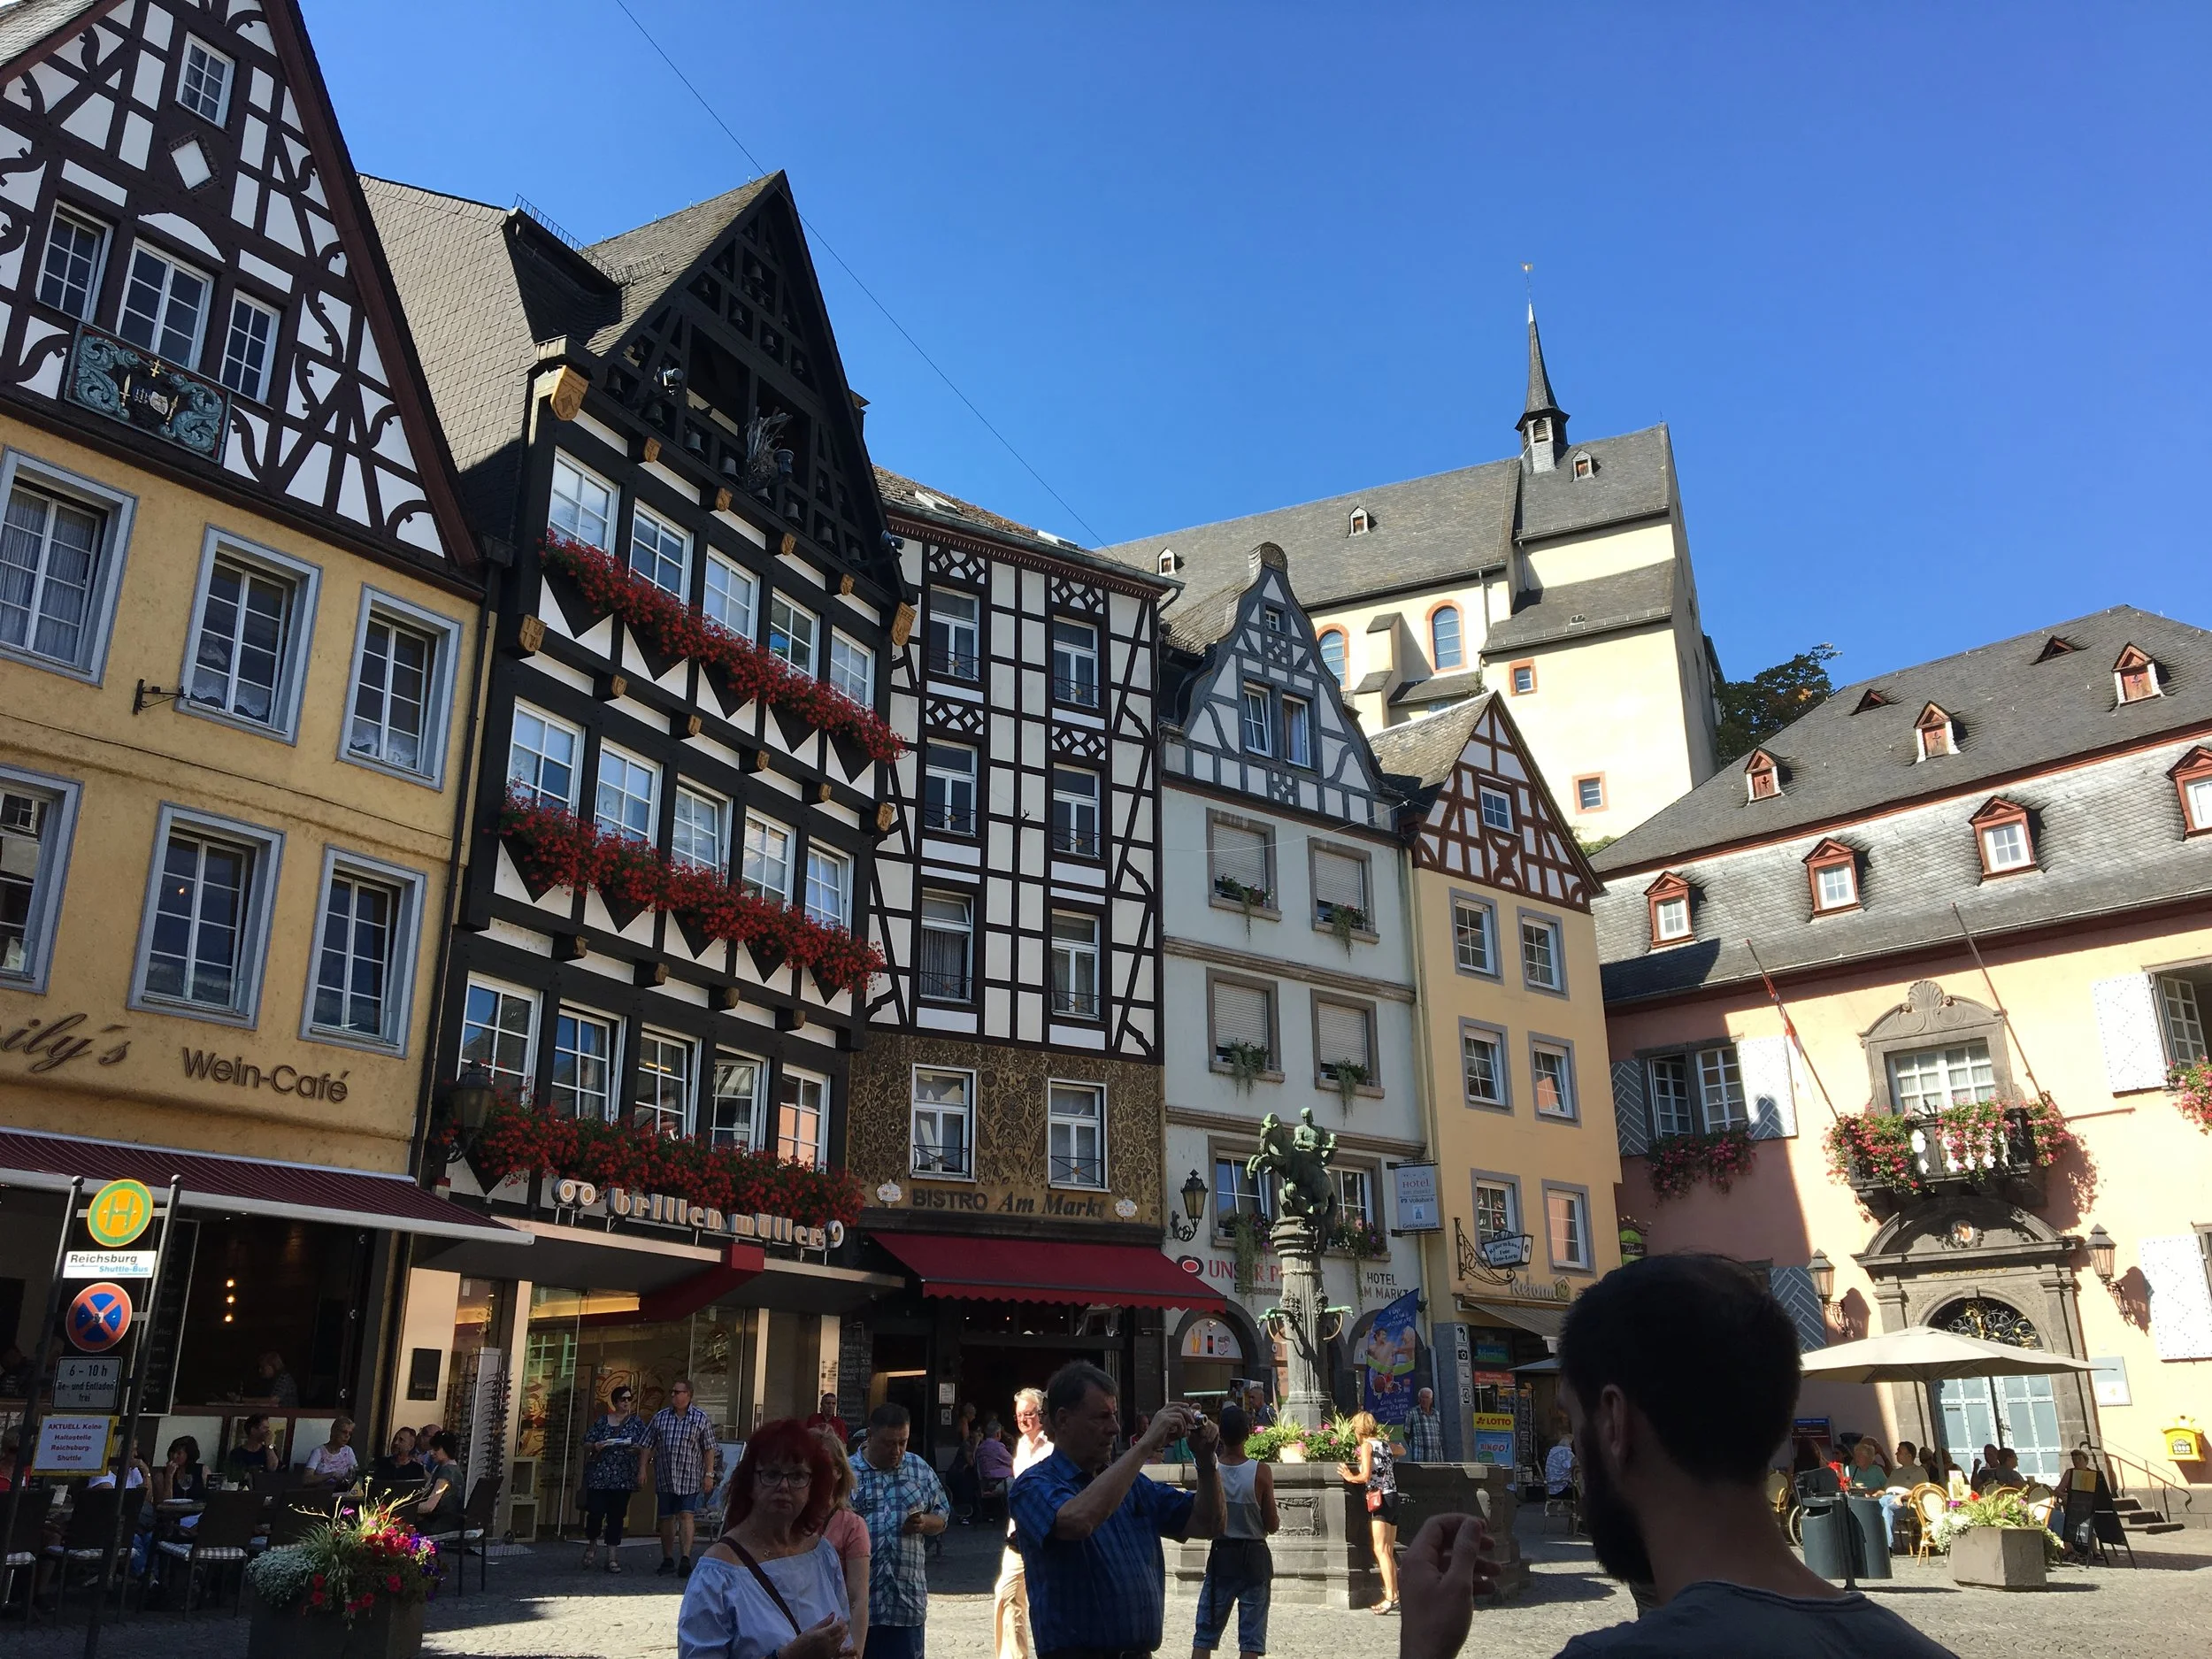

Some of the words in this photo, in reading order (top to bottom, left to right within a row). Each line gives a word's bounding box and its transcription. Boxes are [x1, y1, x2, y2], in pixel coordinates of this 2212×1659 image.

[182, 1046, 350, 1103] Wein-Café
[911, 1187, 988, 1211] BISTRO
[997, 1191, 1034, 1213] Am
[1041, 1193, 1107, 1218] Markt
[105, 1195, 134, 1231] H
[605, 1187, 727, 1233] brillen
[728, 1212, 826, 1248] müller
[70, 1254, 138, 1265] Reichsburg
[99, 1263, 149, 1273] Shuttle-Bus
[1209, 1259, 1264, 1283] UNSR
[1367, 1272, 1397, 1286] HOTEL
[1362, 1286, 1372, 1298] M
[69, 1364, 75, 1377] 6
[88, 1364, 98, 1376] 10
[101, 1364, 108, 1376] h
[71, 1381, 84, 1390] und
[86, 1381, 114, 1391] Entladen
[1486, 1417, 1511, 1426] LOTTO
[1479, 1443, 1509, 1453] BINGO!
